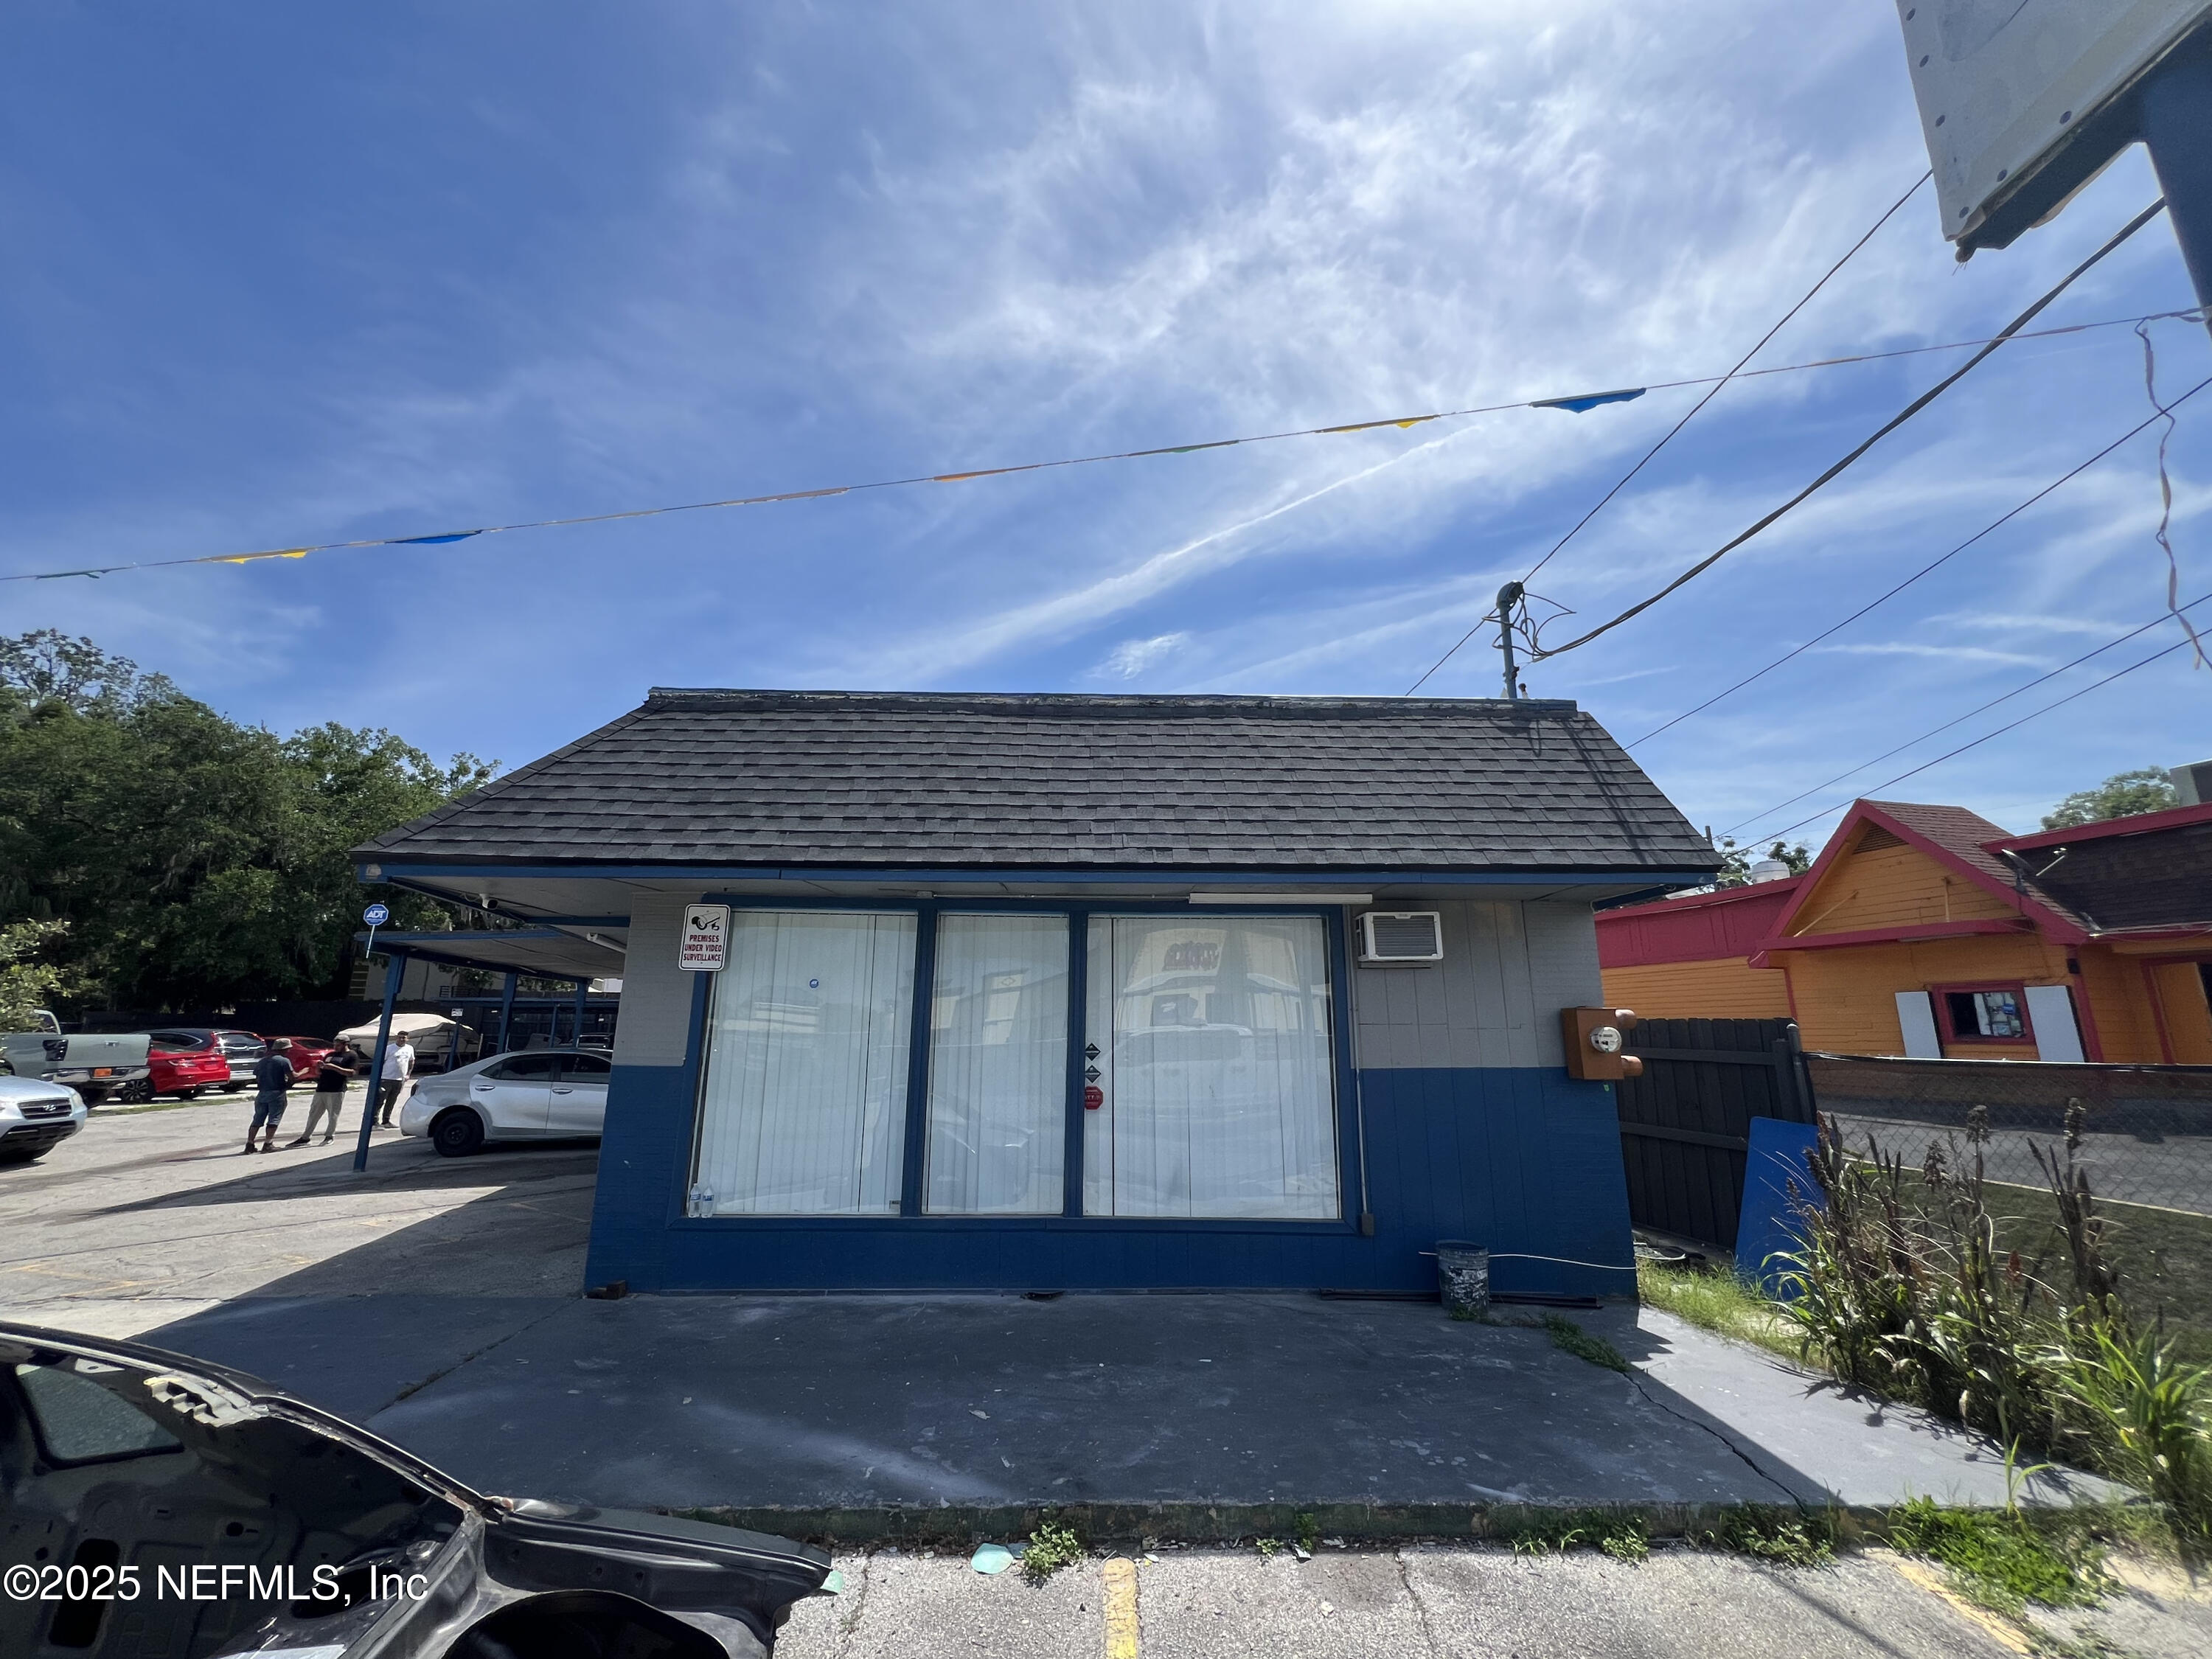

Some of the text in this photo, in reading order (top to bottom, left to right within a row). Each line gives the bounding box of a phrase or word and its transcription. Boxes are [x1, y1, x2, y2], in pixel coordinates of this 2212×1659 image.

[366, 910, 386, 919] ADT
[689, 934, 720, 942] PREMISES
[684, 944, 703, 952] UNDER
[683, 953, 722, 961] SURVEILLANCE
